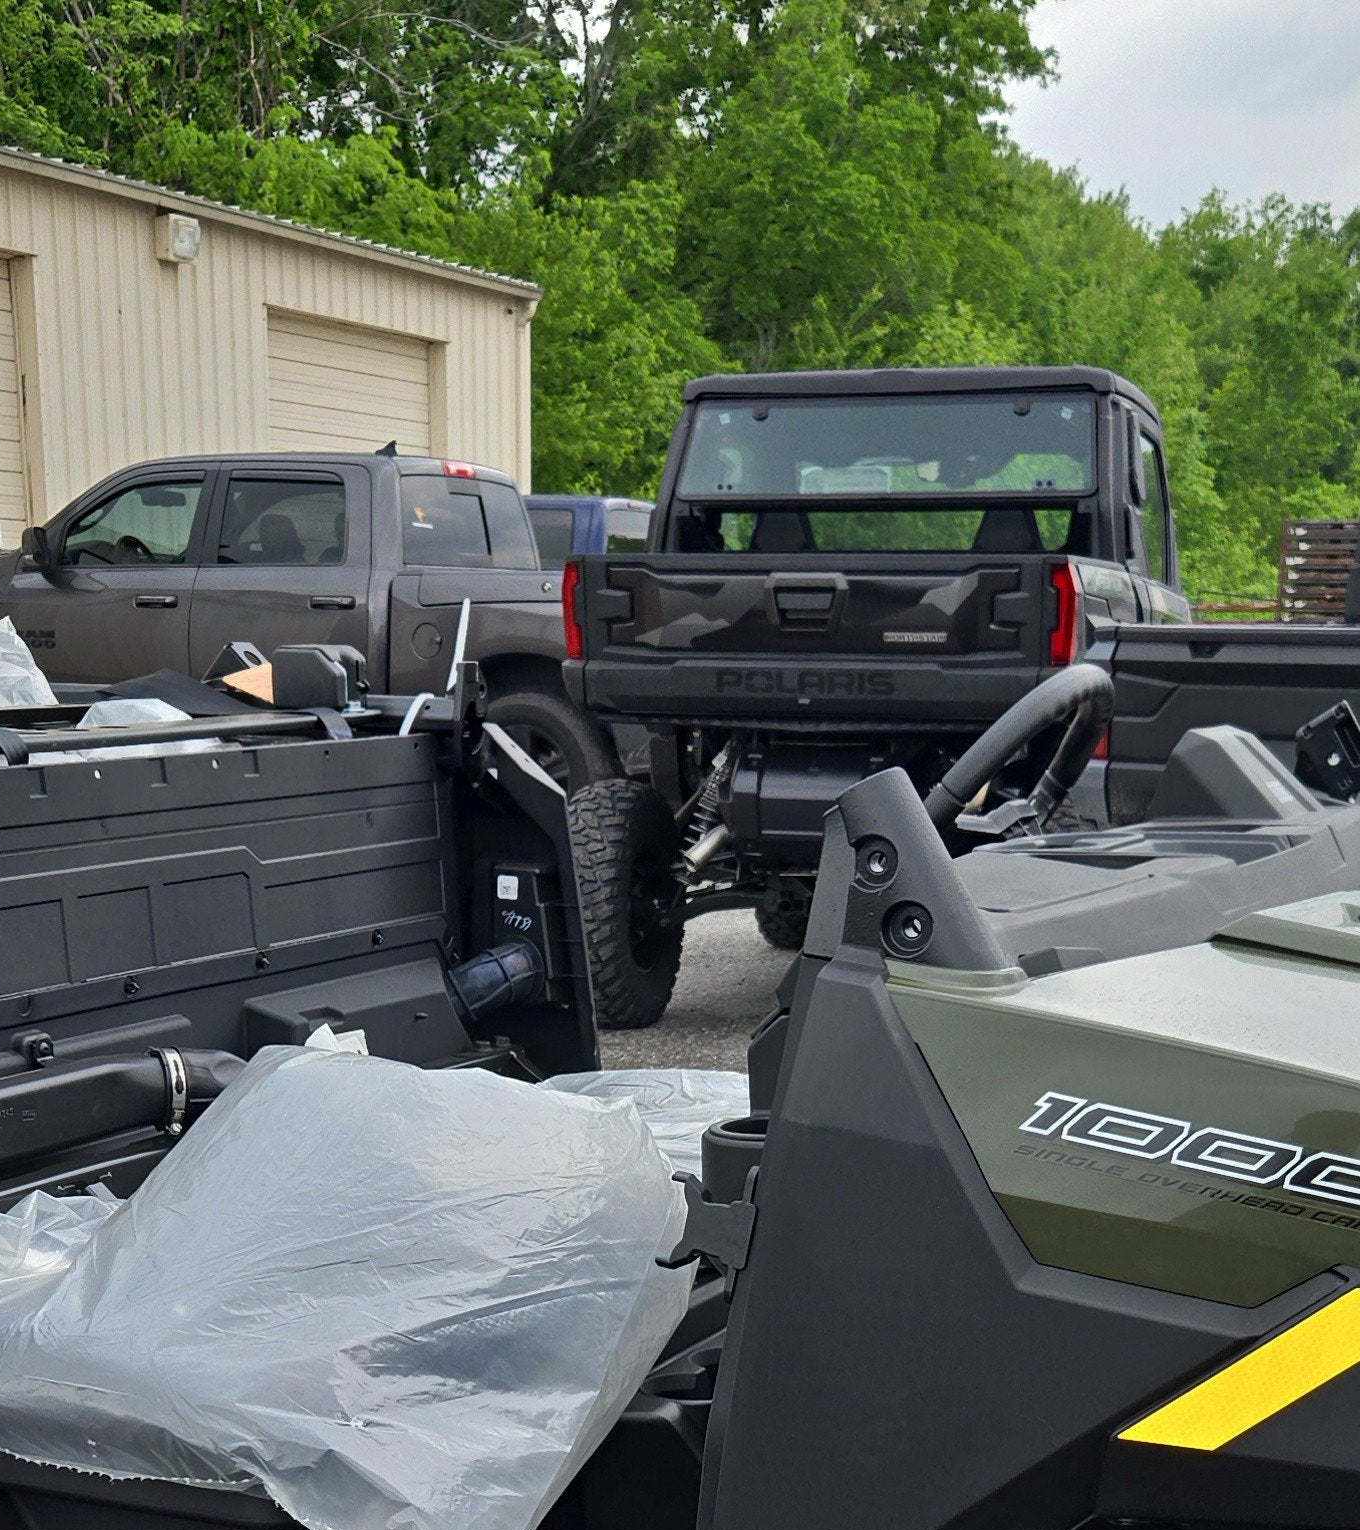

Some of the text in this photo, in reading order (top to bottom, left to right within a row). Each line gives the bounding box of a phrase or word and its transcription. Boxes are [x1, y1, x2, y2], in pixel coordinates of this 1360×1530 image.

[716, 668, 895, 695] POLARIS
[1013, 1143, 1129, 1177] SINGLE
[1138, 1174, 1306, 1218] OVERHEAD
